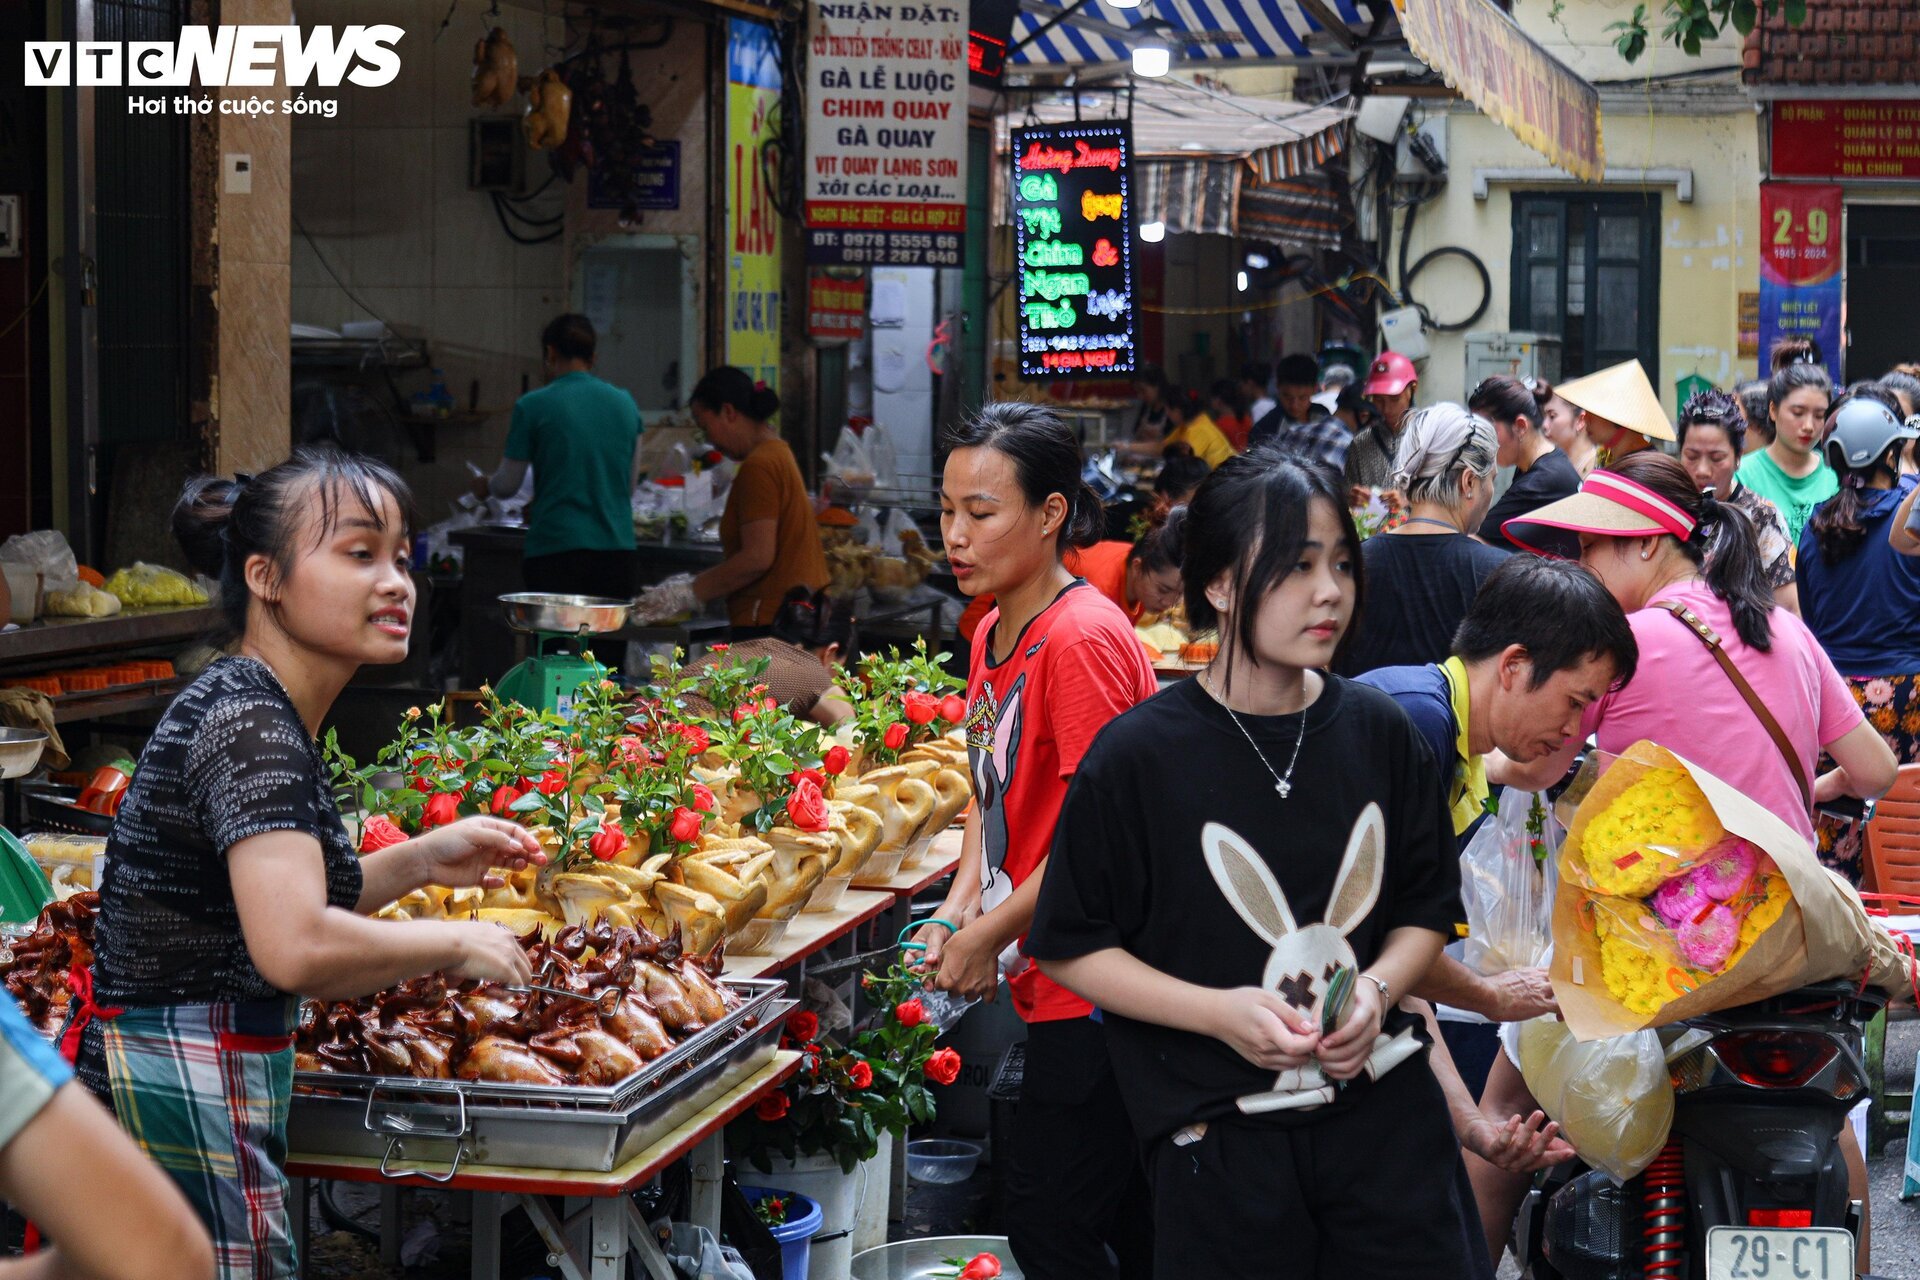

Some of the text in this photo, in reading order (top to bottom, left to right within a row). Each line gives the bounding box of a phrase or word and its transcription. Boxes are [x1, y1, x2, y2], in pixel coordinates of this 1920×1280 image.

[819, 2, 960, 25] NHẬN ĐẶT:
[907, 37, 933, 59] CHAY
[821, 65, 954, 95] GÀ LỄ LUỘC
[823, 99, 951, 120] CHIM QUAY
[838, 125, 935, 149] GÀ QUAY
[816, 157, 958, 180] VỊT QUAY LẠNG SƠN
[818, 179, 849, 195] XÔI
[855, 180, 891, 196] CÁC
[813, 232, 958, 249] ĐT: 0978 5555 66
[843, 249, 885, 262] 0912
[890, 249, 921, 263] 287
[1774, 247, 1796, 259] 1945
[1804, 246, 1827, 259] 2024
[1731, 1235, 1828, 1279] 29-C1
